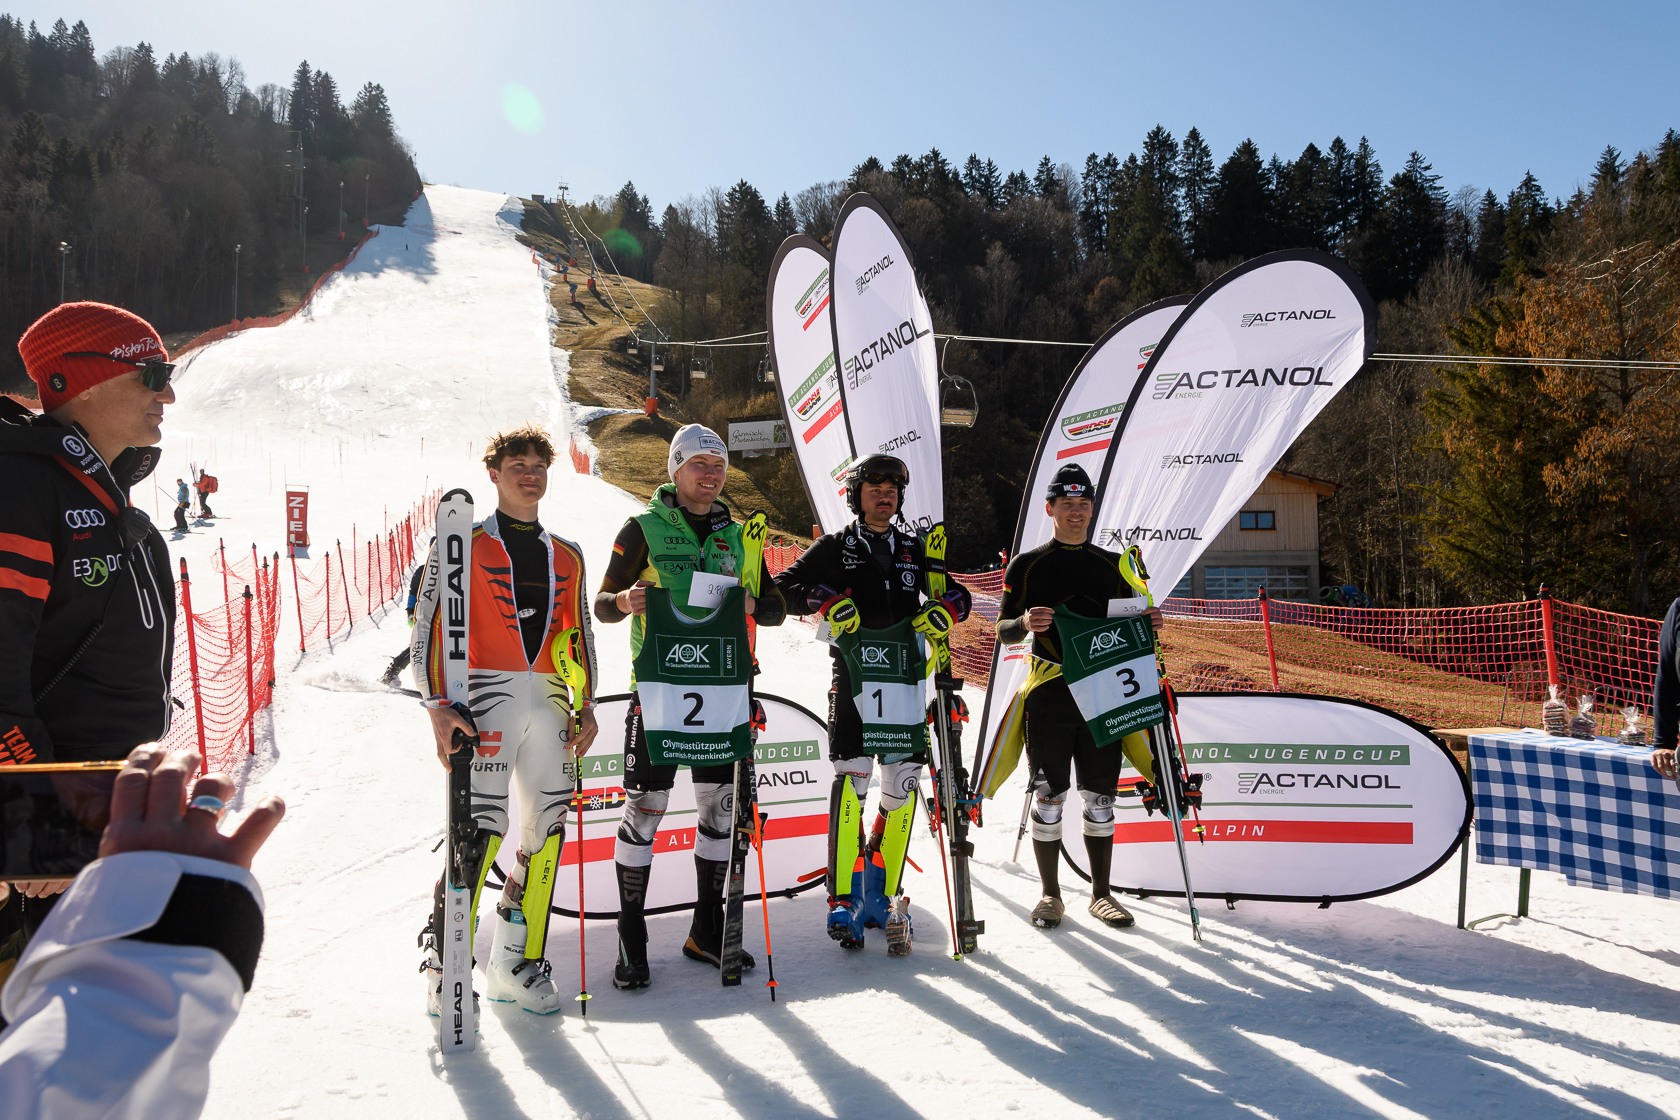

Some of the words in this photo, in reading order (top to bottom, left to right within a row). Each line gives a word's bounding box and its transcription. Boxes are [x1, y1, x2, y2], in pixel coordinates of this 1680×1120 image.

[857, 255, 894, 293] ACTANOL
[1248, 310, 1336, 327] ACTANOL
[854, 318, 930, 388] ACTANOL
[1165, 367, 1333, 399] ACTANOL
[1064, 416, 1081, 425] DSV
[1086, 405, 1123, 419] ACTANO
[883, 430, 921, 455] ACTANOL
[1168, 453, 1244, 468] ACTANOL
[73, 531, 92, 541] Audi
[423, 558, 439, 602] Audi
[447, 534, 466, 660] HEAD
[665, 644, 710, 663] AOK
[1089, 627, 1127, 655] AOK
[558, 650, 570, 678] LEKI
[1116, 668, 1141, 698] 3
[683, 692, 705, 726] 2
[871, 688, 883, 718] 1
[3, 725, 37, 765] TEAM
[1249, 749, 1401, 760] JUGENDCUP
[757, 770, 817, 788] ANOL
[1250, 773, 1401, 794] ACTANOL
[901, 813, 909, 833] LEKI
[541, 860, 552, 885] LEKI
[454, 981, 463, 1045] HEAD
